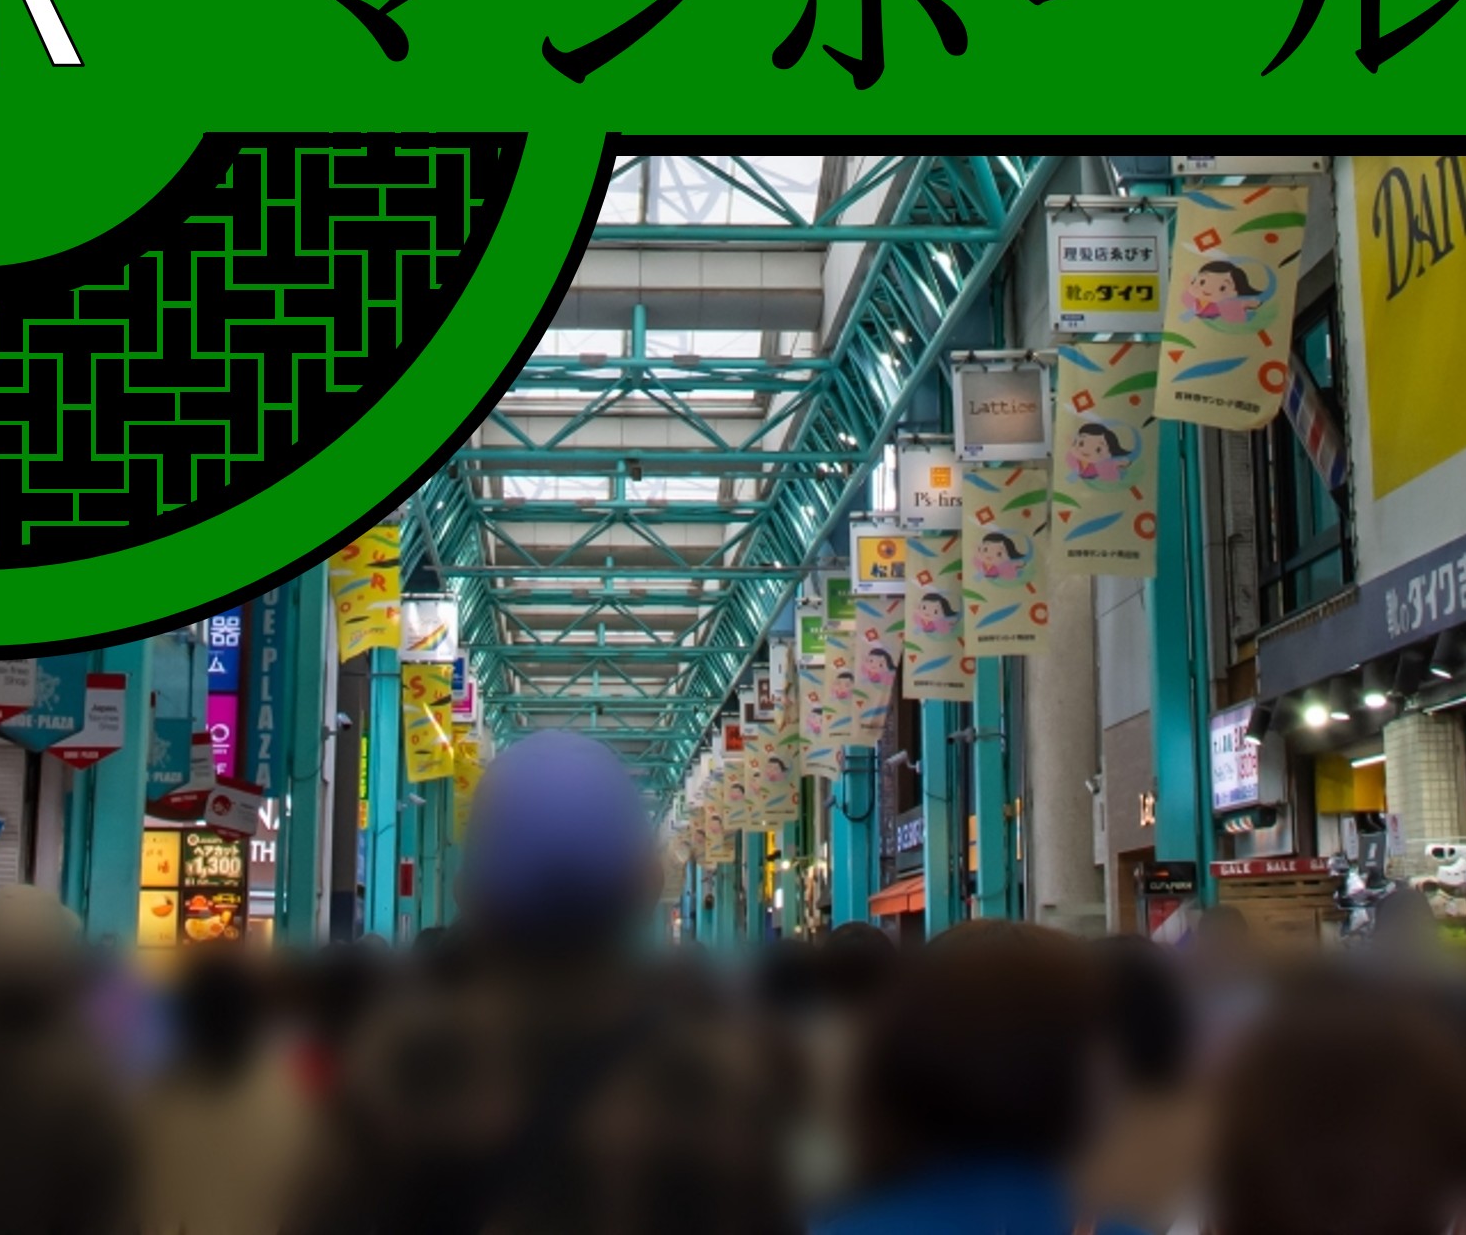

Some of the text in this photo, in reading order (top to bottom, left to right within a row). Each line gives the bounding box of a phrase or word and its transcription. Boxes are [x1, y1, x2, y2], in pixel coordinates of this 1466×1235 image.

[1066, 284, 1153, 302] 靴のダイワ
